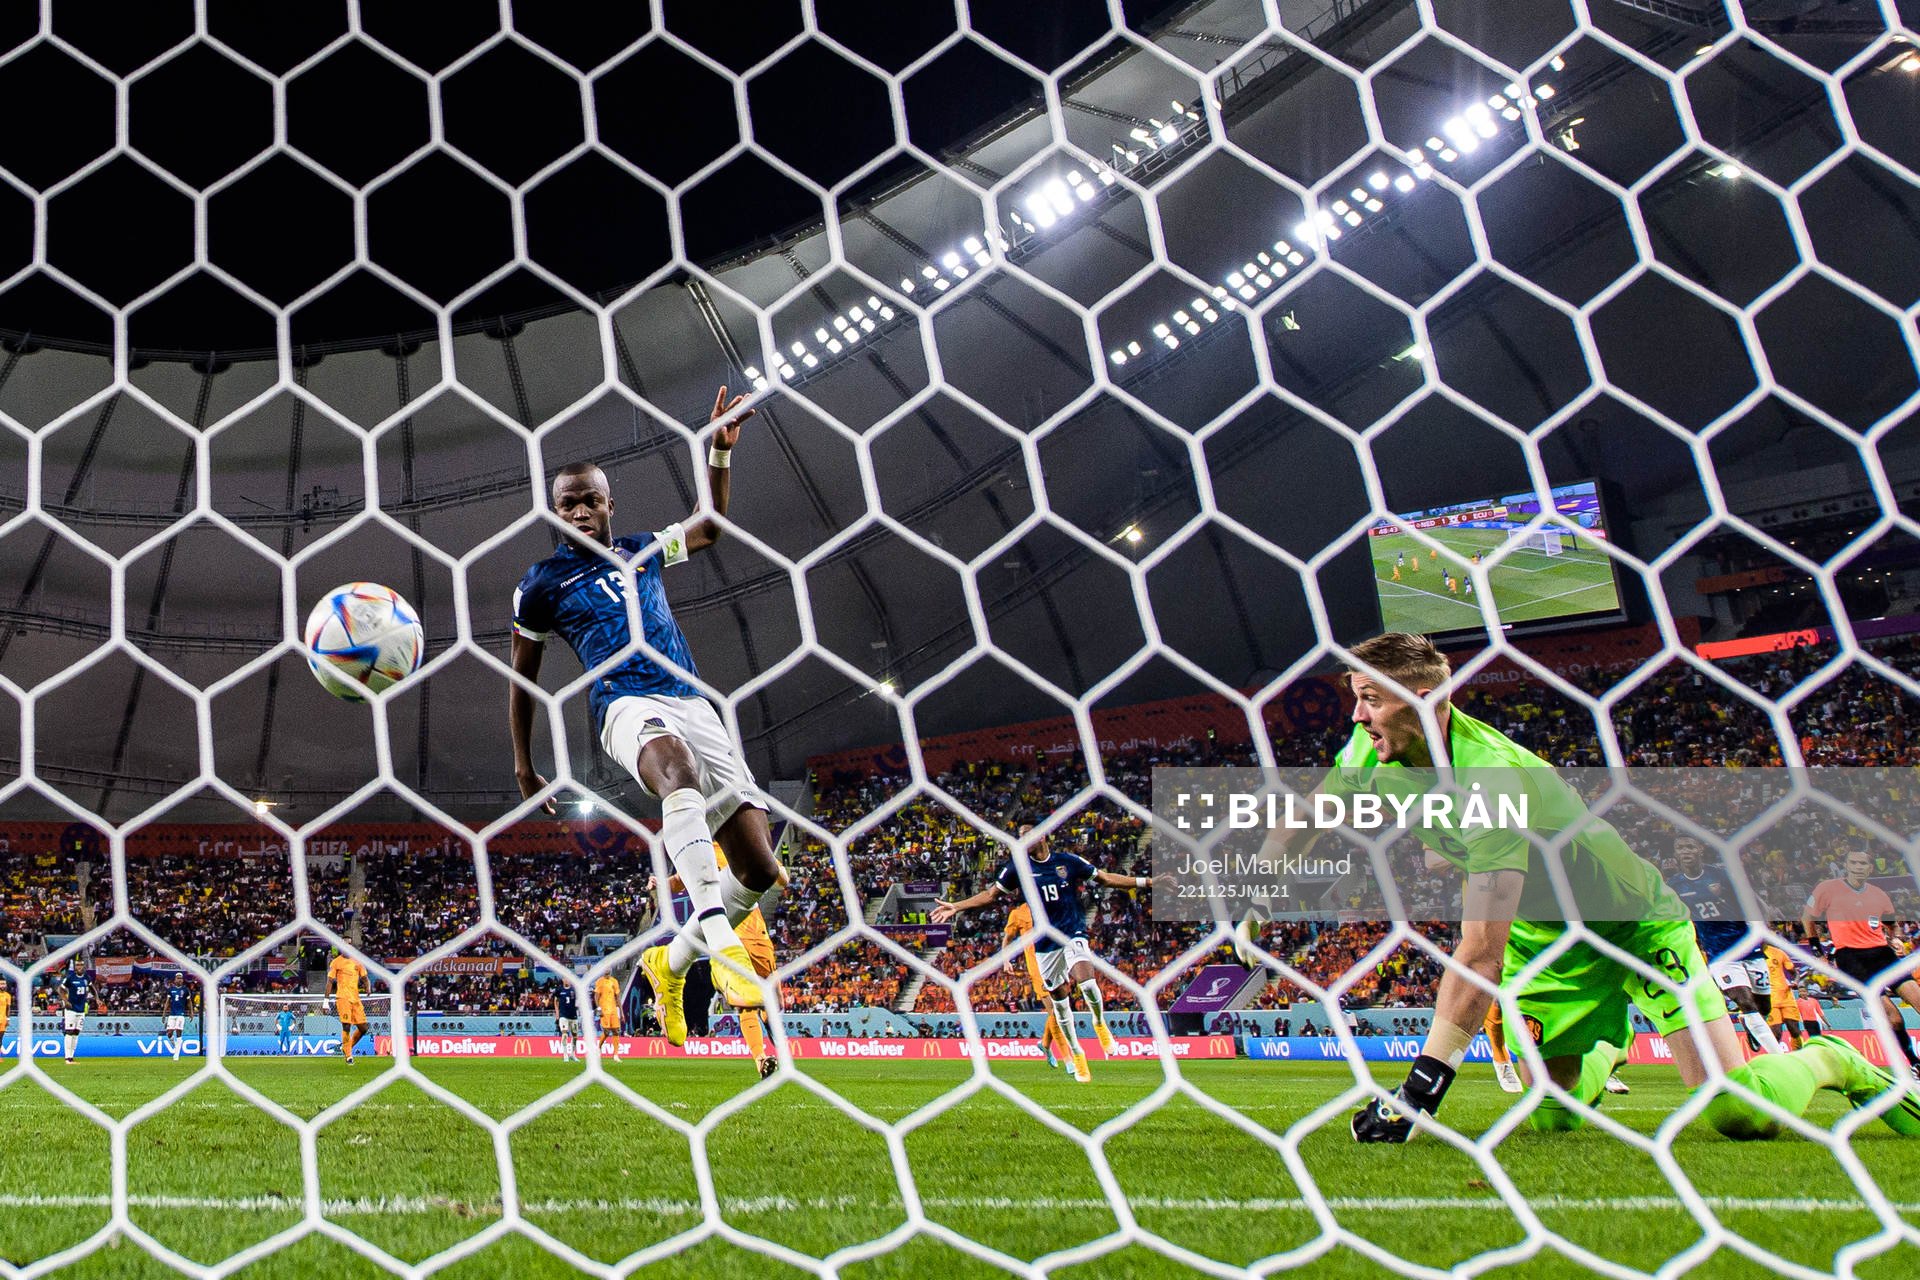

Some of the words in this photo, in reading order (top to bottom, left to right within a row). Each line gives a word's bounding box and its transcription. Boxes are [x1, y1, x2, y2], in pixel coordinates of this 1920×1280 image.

[1420, 520, 1435, 528] NED
[1473, 511, 1487, 519] ECU
[595, 570, 638, 603] 13
[1041, 884, 1060, 902] 19
[1696, 902, 1720, 919] 23
[426, 959, 499, 972] adskanaal
[0, 1036, 61, 1055] vivo
[137, 1036, 200, 1055] vivo
[278, 1036, 343, 1054] vivo
[417, 1039, 440, 1054] We
[442, 1038, 497, 1054] Deliver
[576, 1039, 631, 1054] Diver
[684, 1040, 708, 1055] We
[711, 1038, 766, 1055] Deliv
[820, 1041, 846, 1056] We
[848, 1039, 905, 1056] Deliver
[959, 1042, 984, 1056] We
[1130, 1040, 1190, 1056] Deler
[1261, 1038, 1290, 1057] vivo
[1384, 1036, 1420, 1058] vivo
[1470, 1035, 1493, 1058] viv
[1650, 1038, 1672, 1058] We
